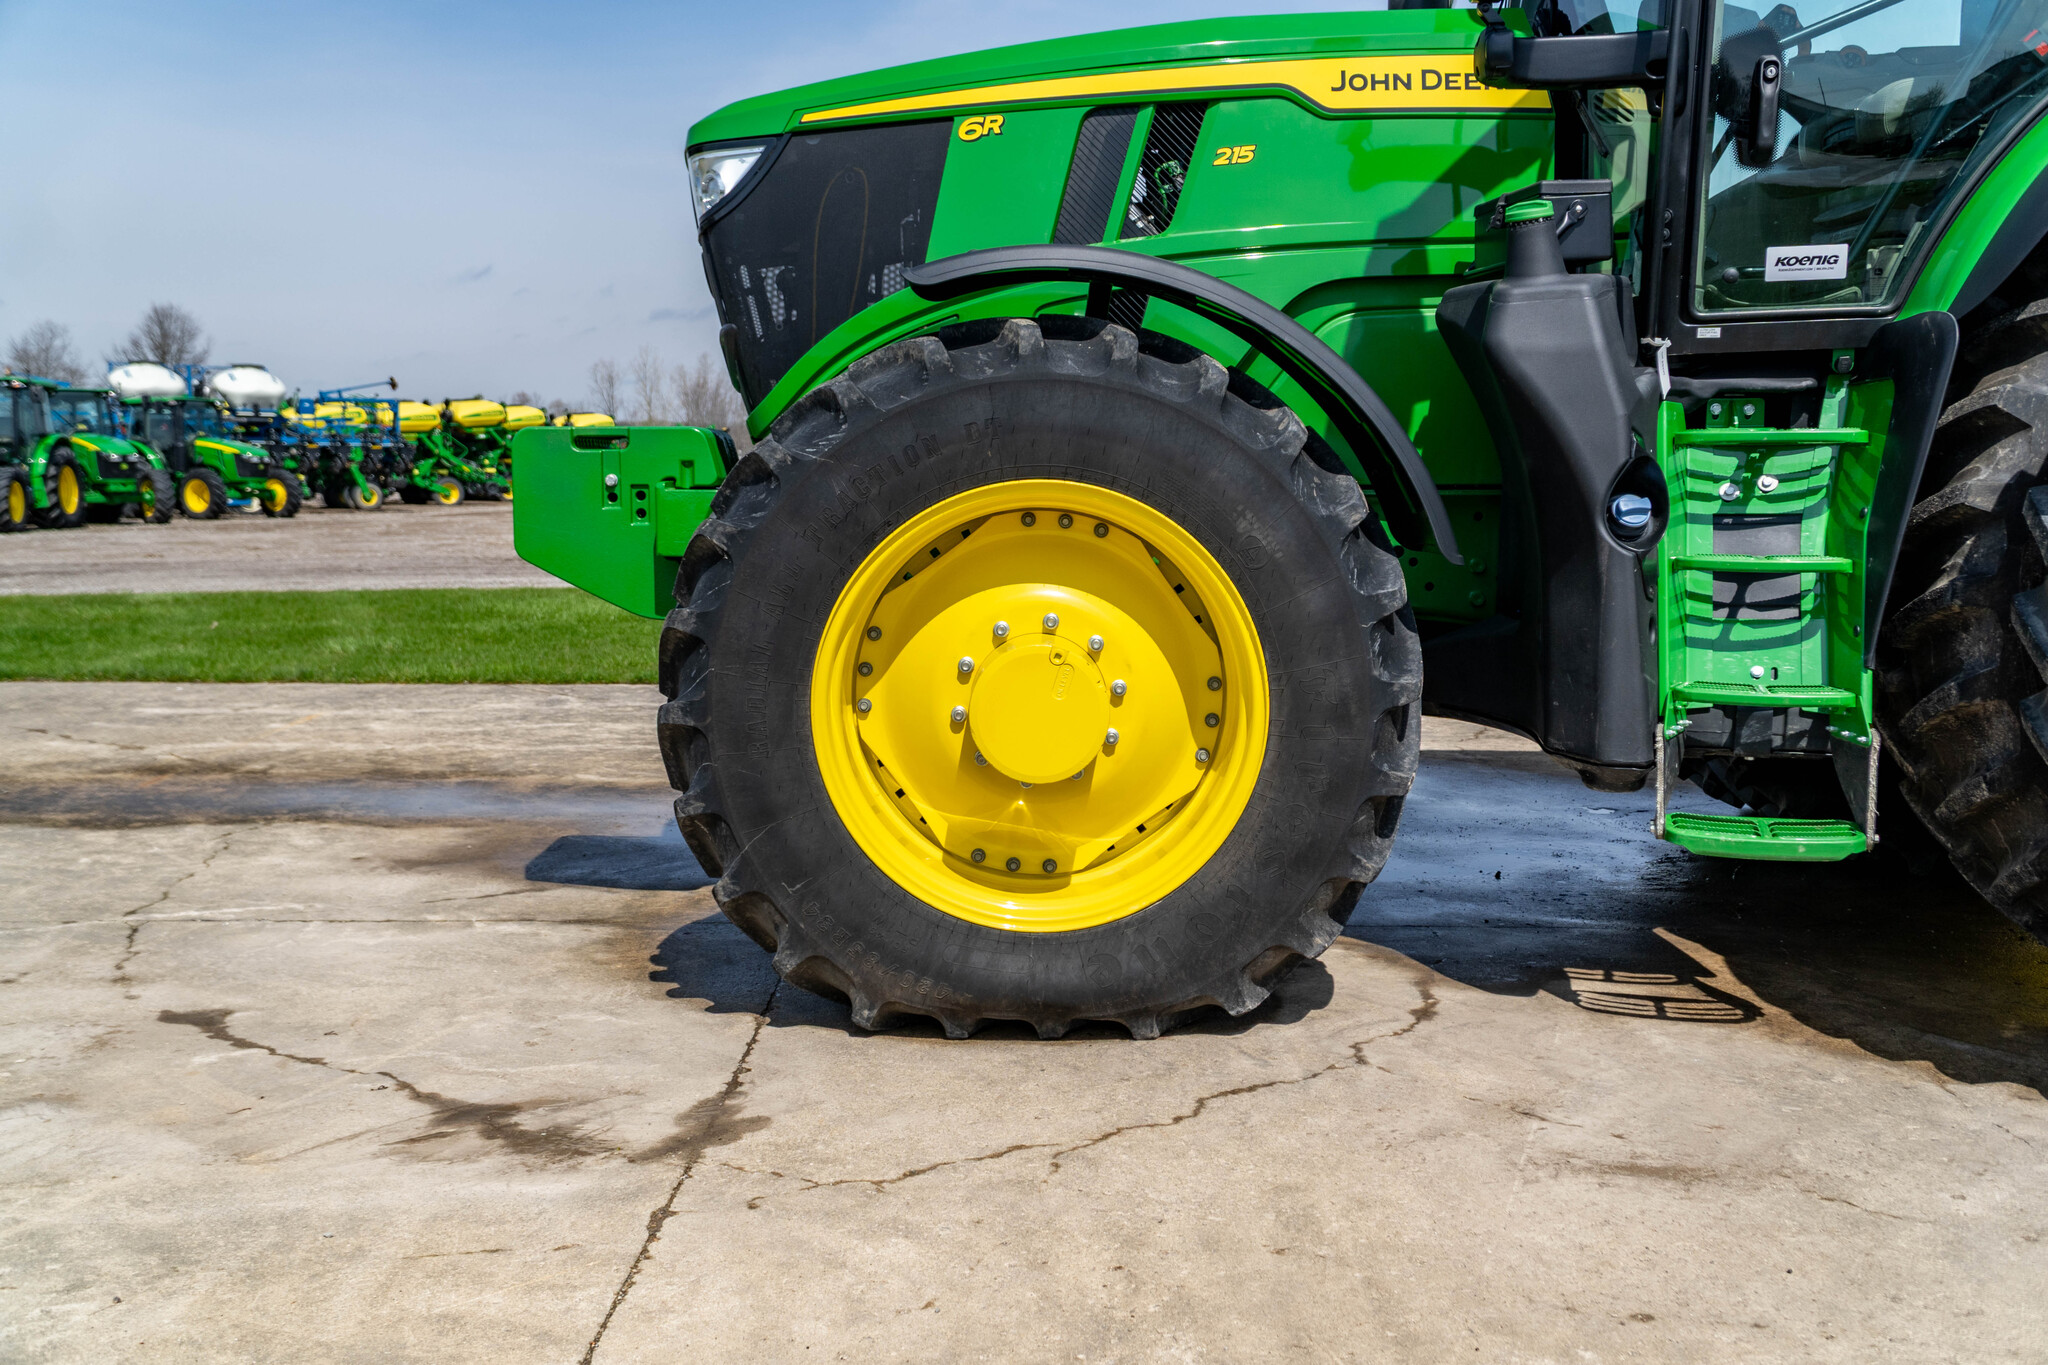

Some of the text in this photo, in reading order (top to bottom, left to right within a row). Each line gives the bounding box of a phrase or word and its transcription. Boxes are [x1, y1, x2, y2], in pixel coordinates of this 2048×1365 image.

[1331, 69, 1506, 91] JOHN DEE
[958, 114, 1005, 143] 6R
[1212, 144, 1257, 166] 215
[744, 640, 776, 760] RADIAL
[800, 433, 943, 546] TRACTION
[963, 416, 1002, 445] DT
